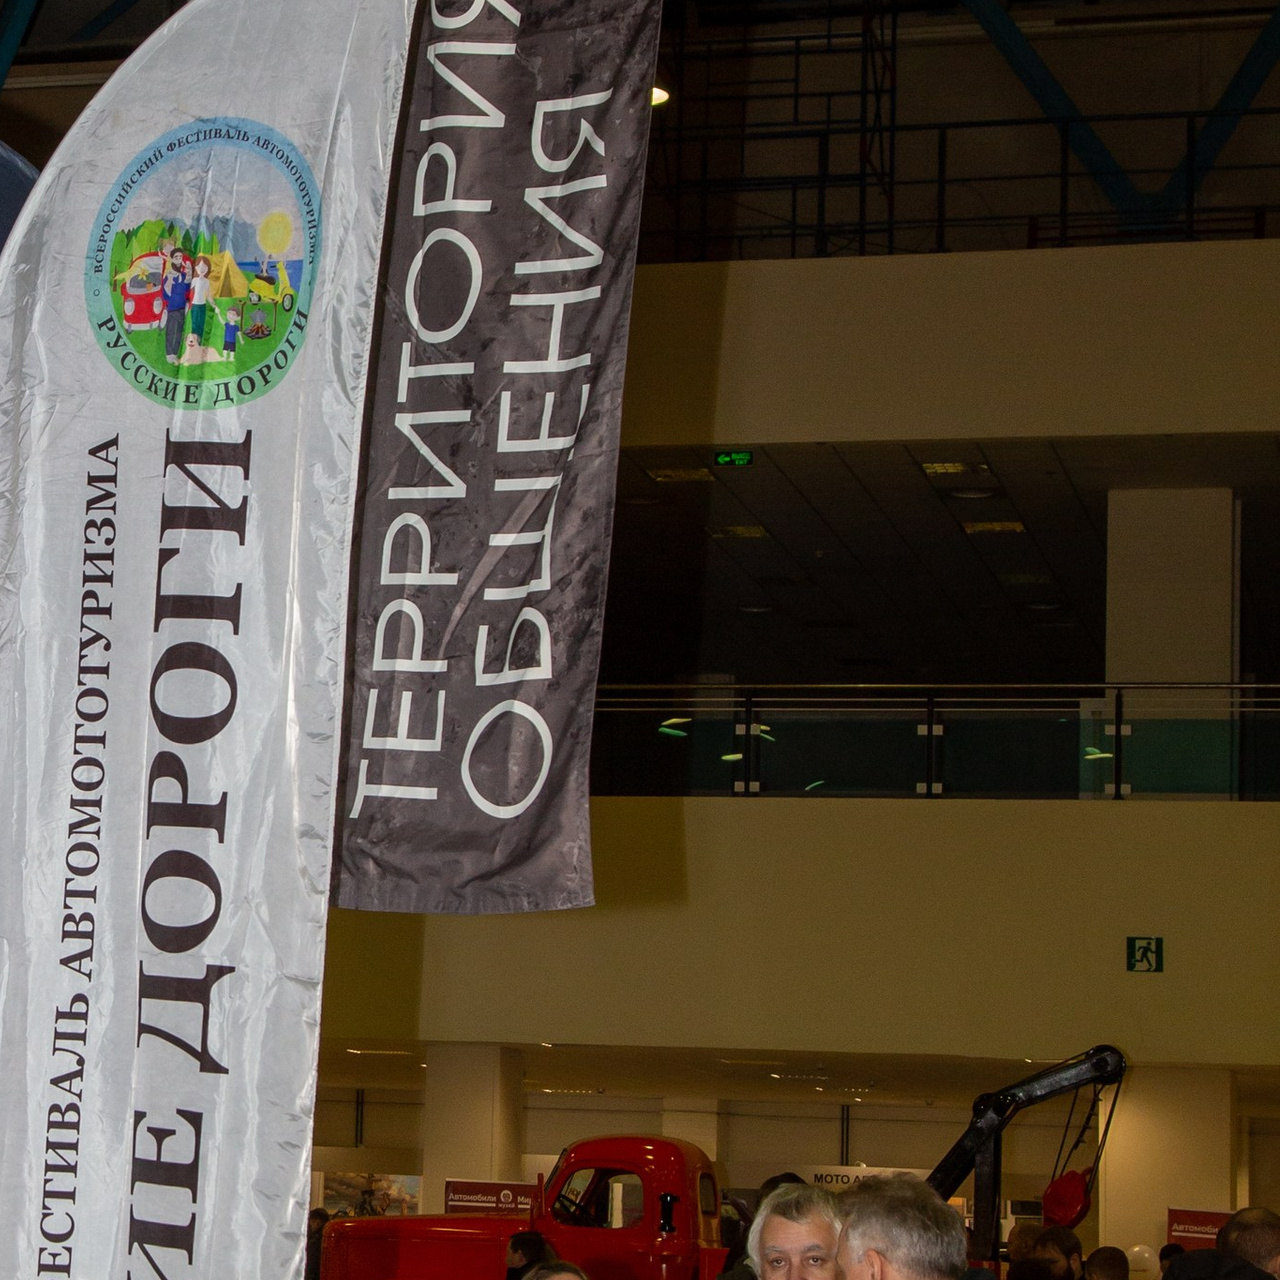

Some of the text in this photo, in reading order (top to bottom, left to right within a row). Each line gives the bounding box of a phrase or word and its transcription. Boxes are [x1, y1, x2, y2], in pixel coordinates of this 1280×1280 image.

[93, 147, 164, 275] ВСЕРОССИЙСКИЙ
[166, 128, 250, 154] ФЕСТИВАЛЬ
[96, 307, 308, 407] РУССКИЕ ДОРОГИ
[461, 87, 613, 821] ОБЩЕНИЯ
[59, 432, 121, 983] АВТОМОТОТУРИЗМА
[136, 428, 253, 1075] ДОРОГИ
[448, 1192, 497, 1202] Автомобили
